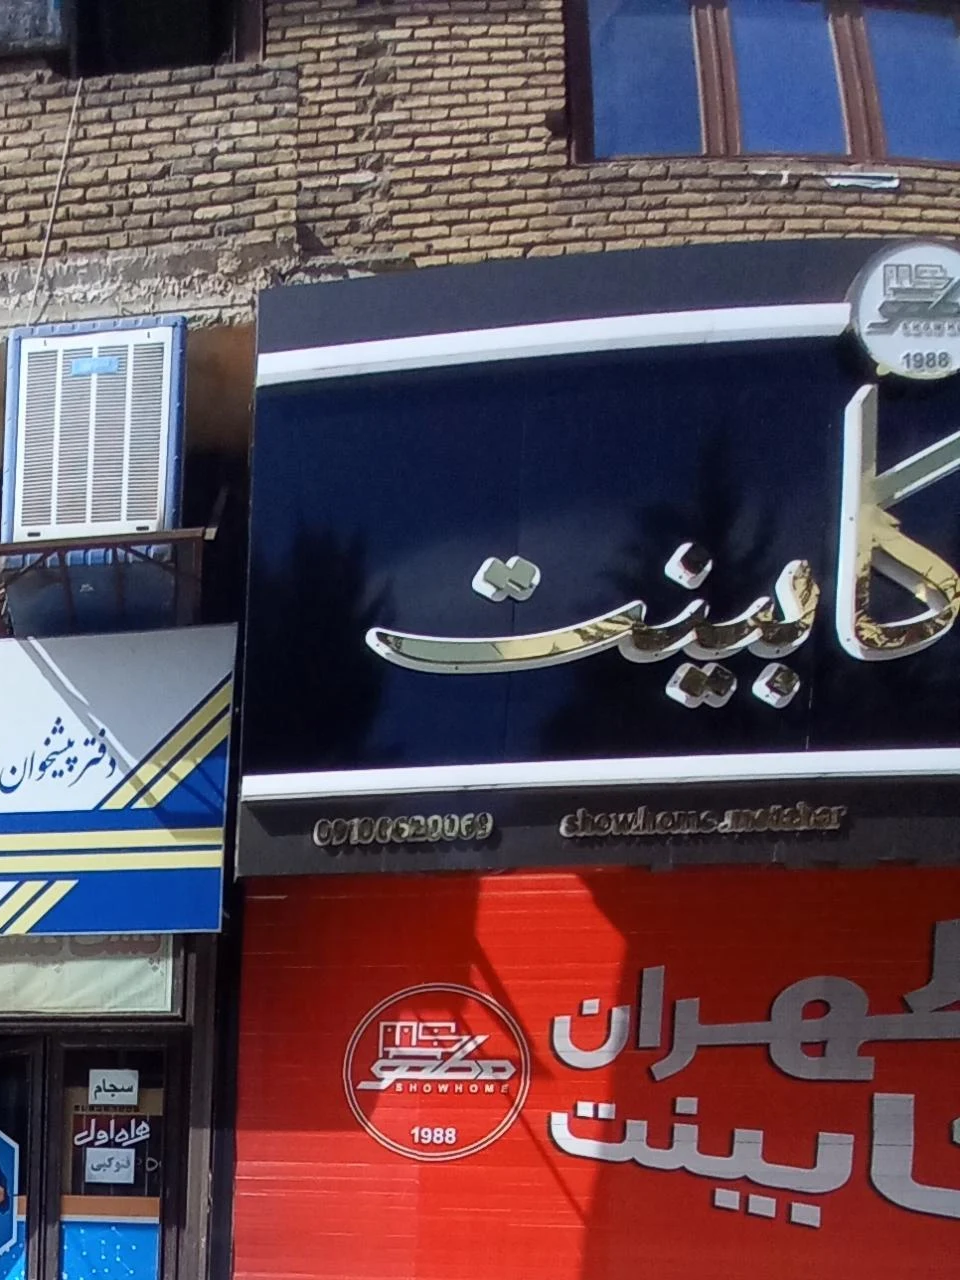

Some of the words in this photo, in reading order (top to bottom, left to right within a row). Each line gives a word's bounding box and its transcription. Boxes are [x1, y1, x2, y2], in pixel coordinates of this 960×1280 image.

[902, 352, 950, 369] 1988
[0, 717, 77, 794] پیشخوان
[68, 728, 117, 787] دفتر
[93, 1078, 134, 1100] سجام
[395, 1082, 510, 1094] SHOWHOME
[411, 1127, 457, 1144] 1988
[551, 1093, 960, 1228] ابینت
